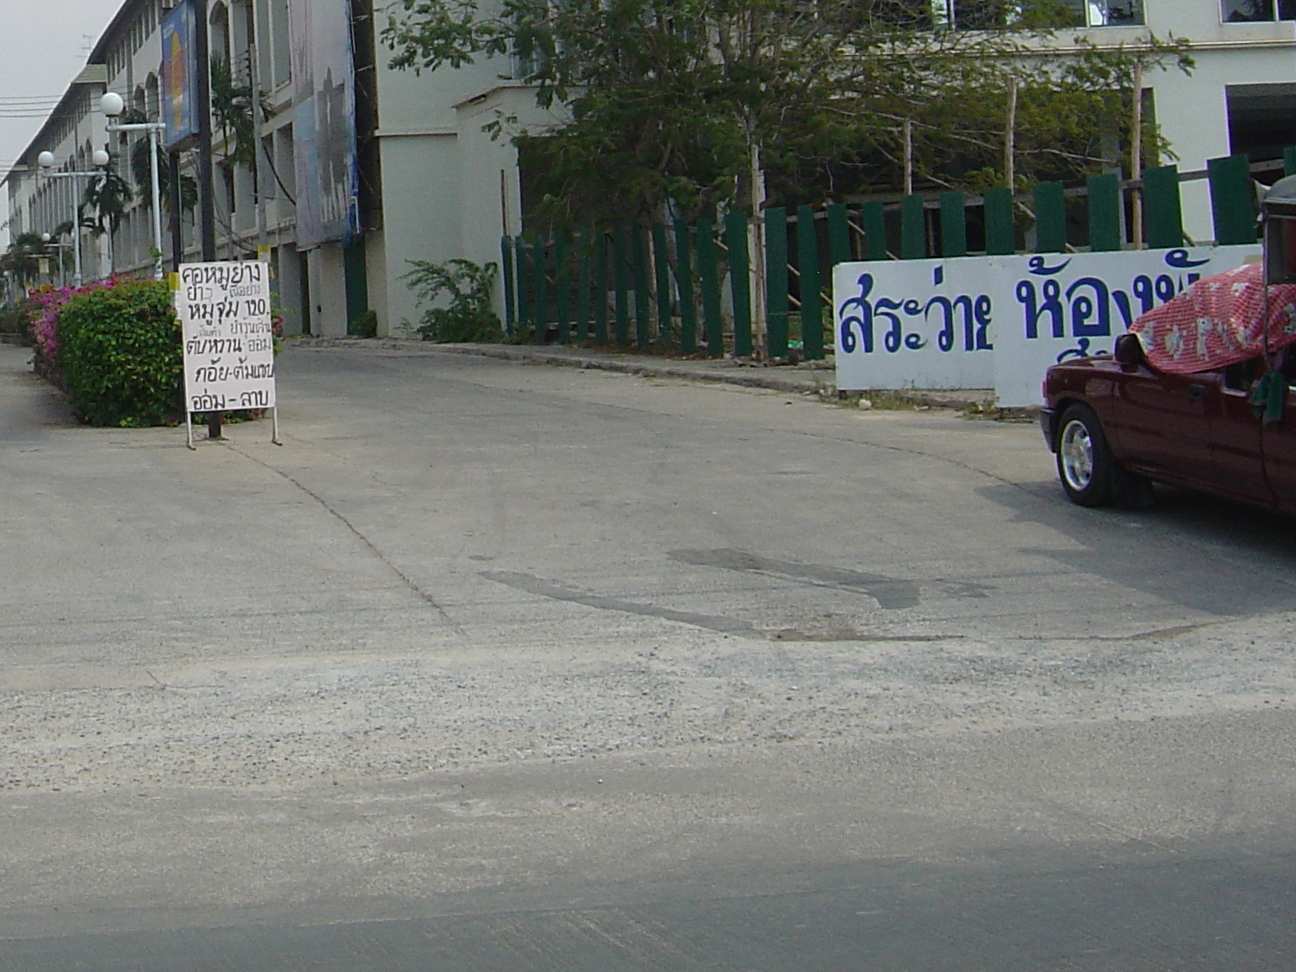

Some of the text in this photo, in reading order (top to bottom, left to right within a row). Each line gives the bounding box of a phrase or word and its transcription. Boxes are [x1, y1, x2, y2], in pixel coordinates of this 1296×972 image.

[182, 261, 261, 291] คอหมูย่าง
[188, 296, 240, 326] หมูจุ่ม
[186, 335, 242, 355] ตับหวาน
[240, 390, 269, 407] ลาบ
